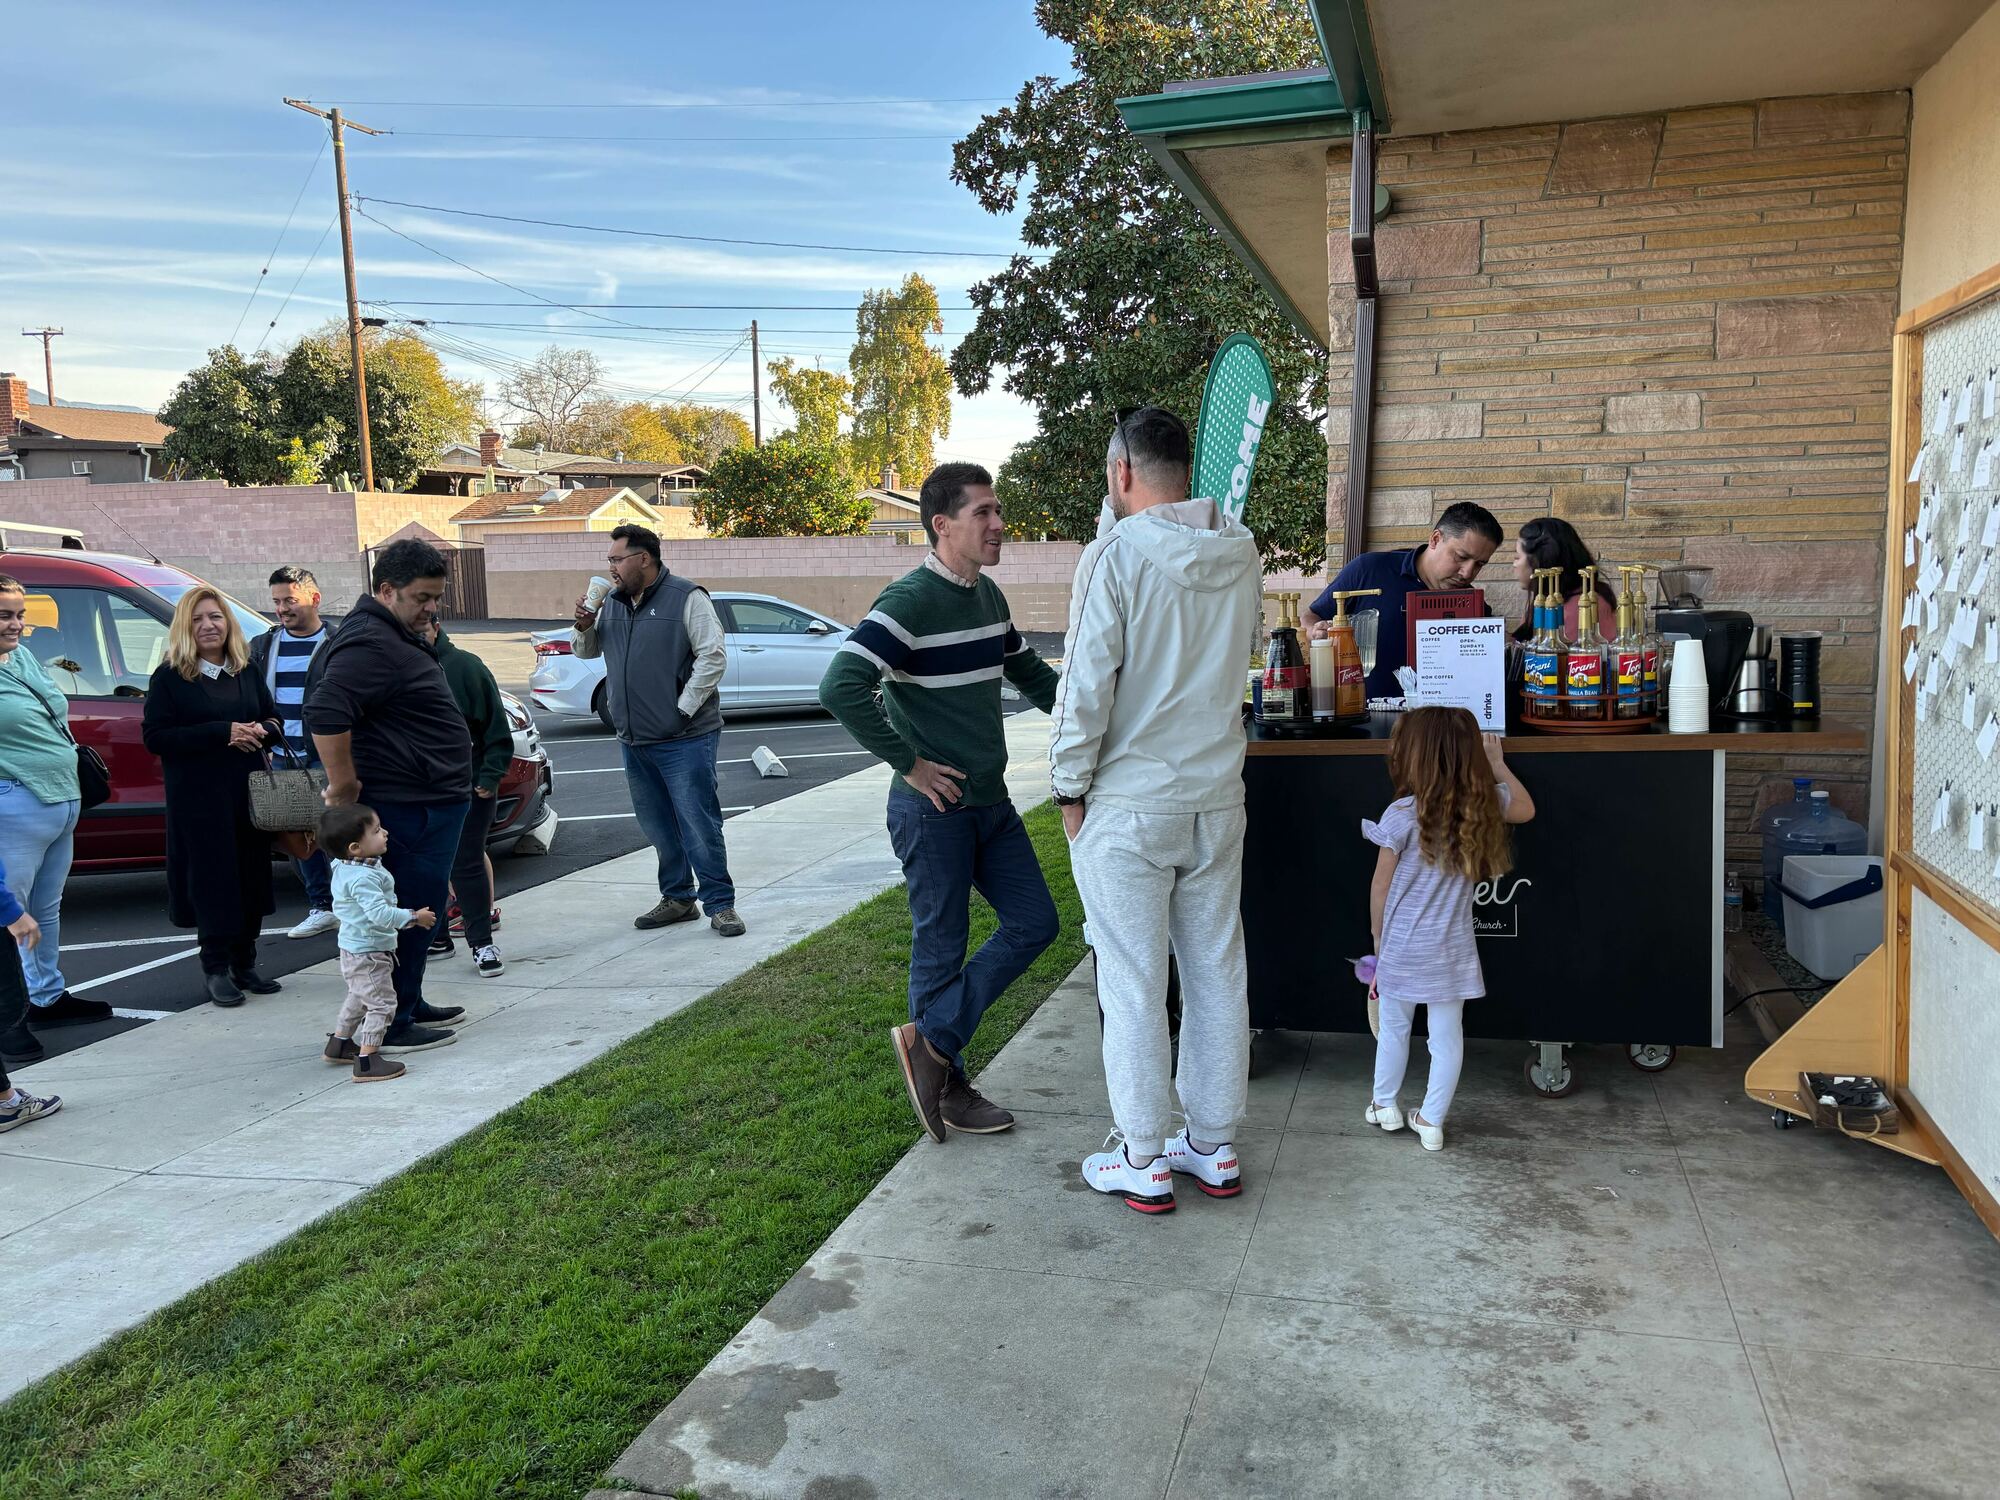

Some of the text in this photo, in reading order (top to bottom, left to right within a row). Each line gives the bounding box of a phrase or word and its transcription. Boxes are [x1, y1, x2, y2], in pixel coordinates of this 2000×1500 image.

[1429, 625, 1502, 635] COFFEE CART
[1568, 659, 1597, 676] Torani
[1484, 693, 1492, 719] drinks
